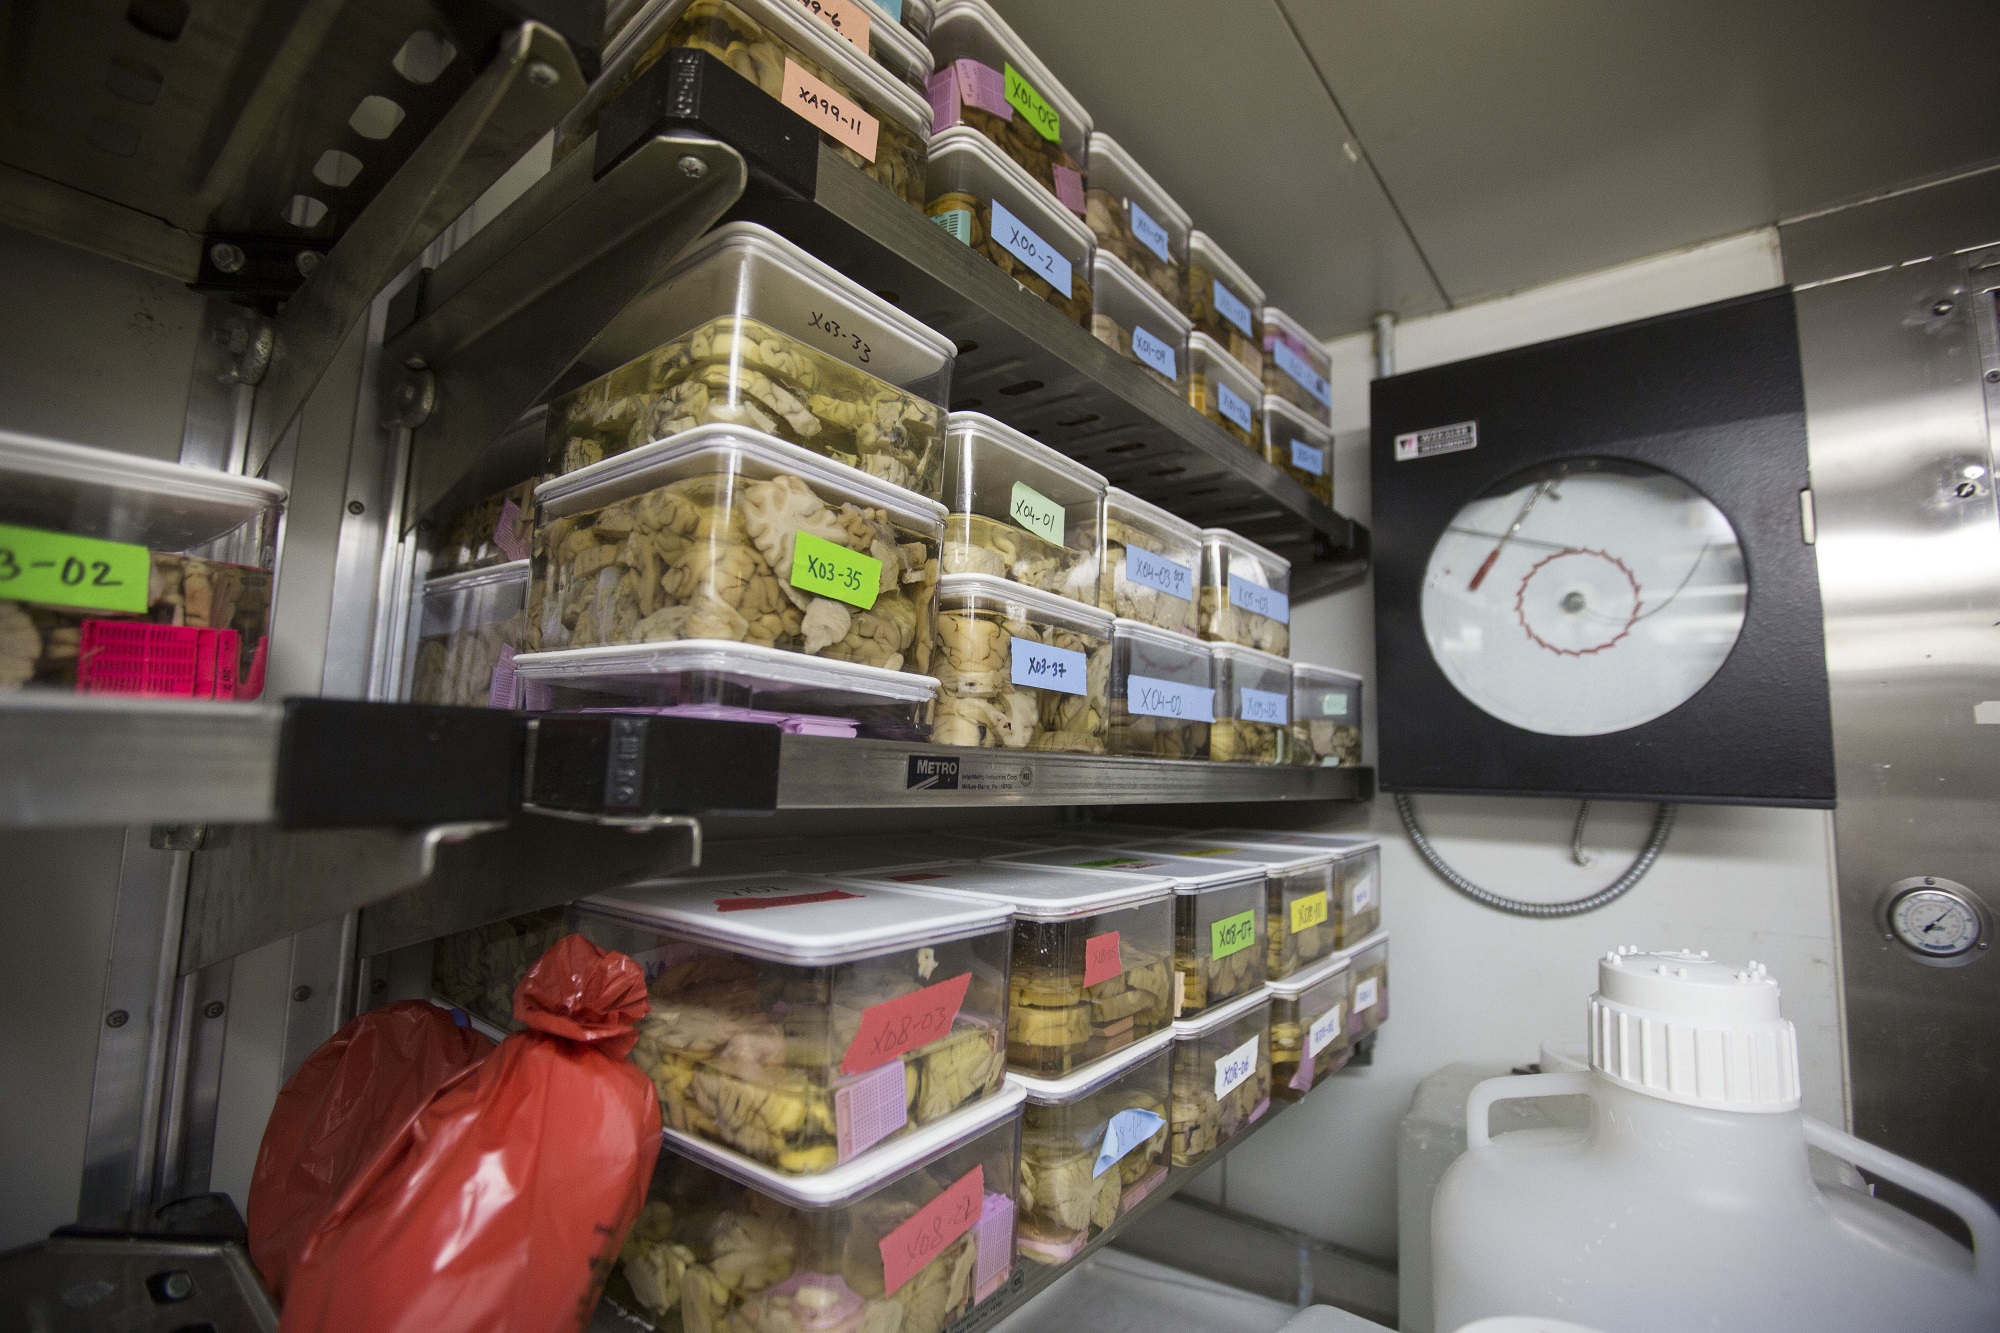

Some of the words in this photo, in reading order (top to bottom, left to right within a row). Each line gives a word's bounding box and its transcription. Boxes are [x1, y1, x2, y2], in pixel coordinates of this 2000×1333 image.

[799, 86, 861, 135] XA99-11
[1009, 226, 1054, 274] X00-2
[808, 311, 871, 362] X03-33
[1016, 500, 1055, 532] X04-01
[808, 554, 862, 591] X03-35
[1136, 557, 1170, 588] X04-03
[1028, 656, 1067, 678] X03-37
[1141, 687, 1182, 715] X04-02
[870, 1007, 945, 1056] X08-03
